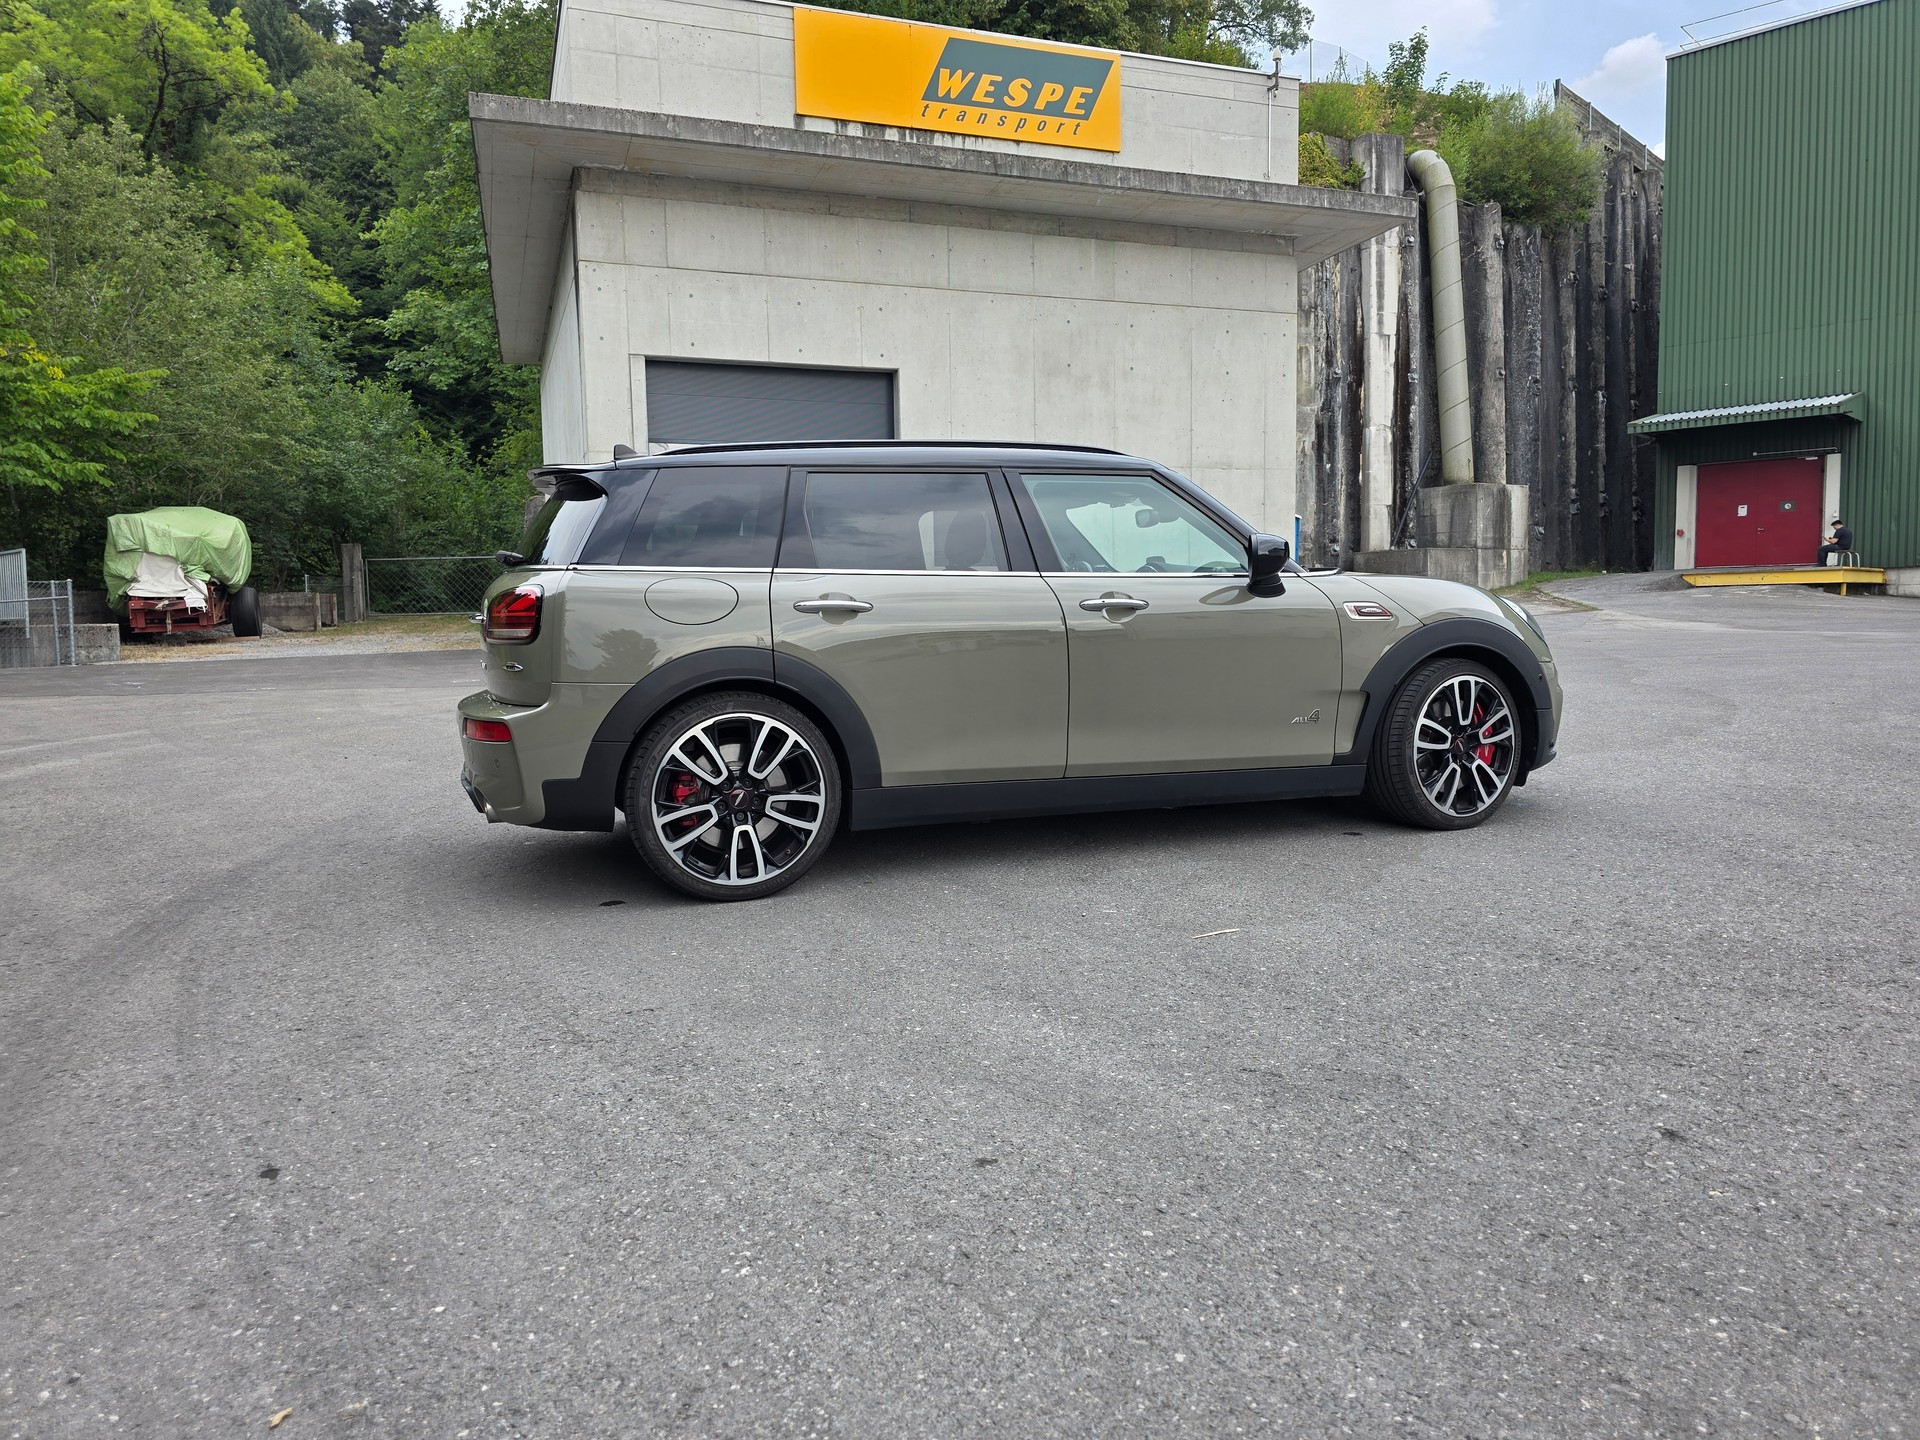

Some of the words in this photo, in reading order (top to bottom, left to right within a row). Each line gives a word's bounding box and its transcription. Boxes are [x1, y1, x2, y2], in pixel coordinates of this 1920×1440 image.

[938, 68, 1093, 115] WESPE
[921, 104, 1081, 135] transport
[1291, 709, 1320, 723] ALL4
